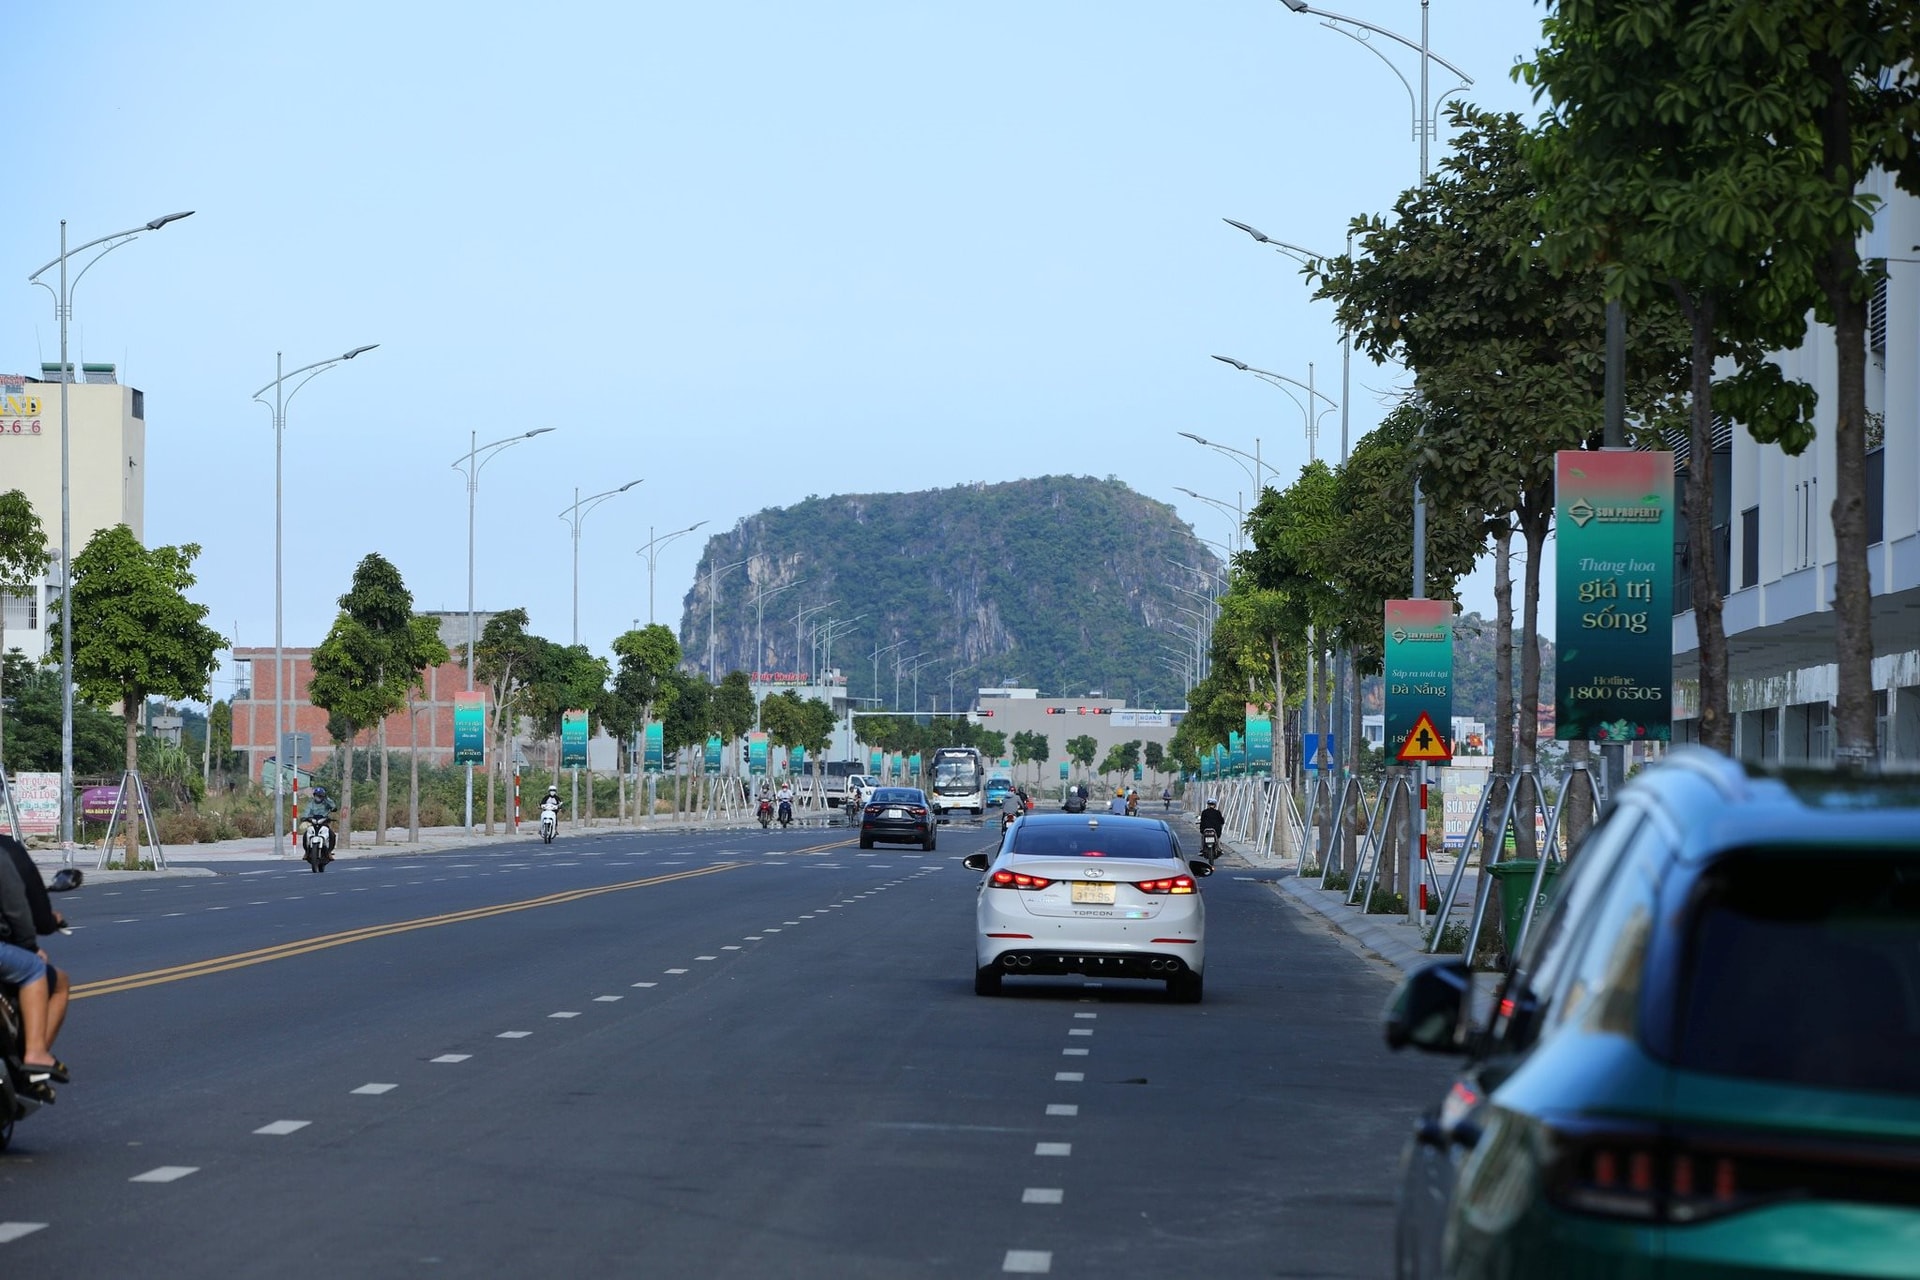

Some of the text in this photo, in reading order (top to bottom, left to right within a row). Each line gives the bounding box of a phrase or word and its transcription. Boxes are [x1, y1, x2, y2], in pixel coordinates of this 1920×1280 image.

[1596, 507, 1660, 517] SUN PROPERTY
[1629, 558, 1655, 573] hoa
[1578, 577, 1652, 602] giá trị
[1582, 605, 1648, 633] sống
[1593, 675, 1634, 685] Hotline
[1391, 682, 1447, 697] Đà Nẵng
[1568, 686, 1662, 701] 1800 6505
[1466, 800, 1477, 813] XE
